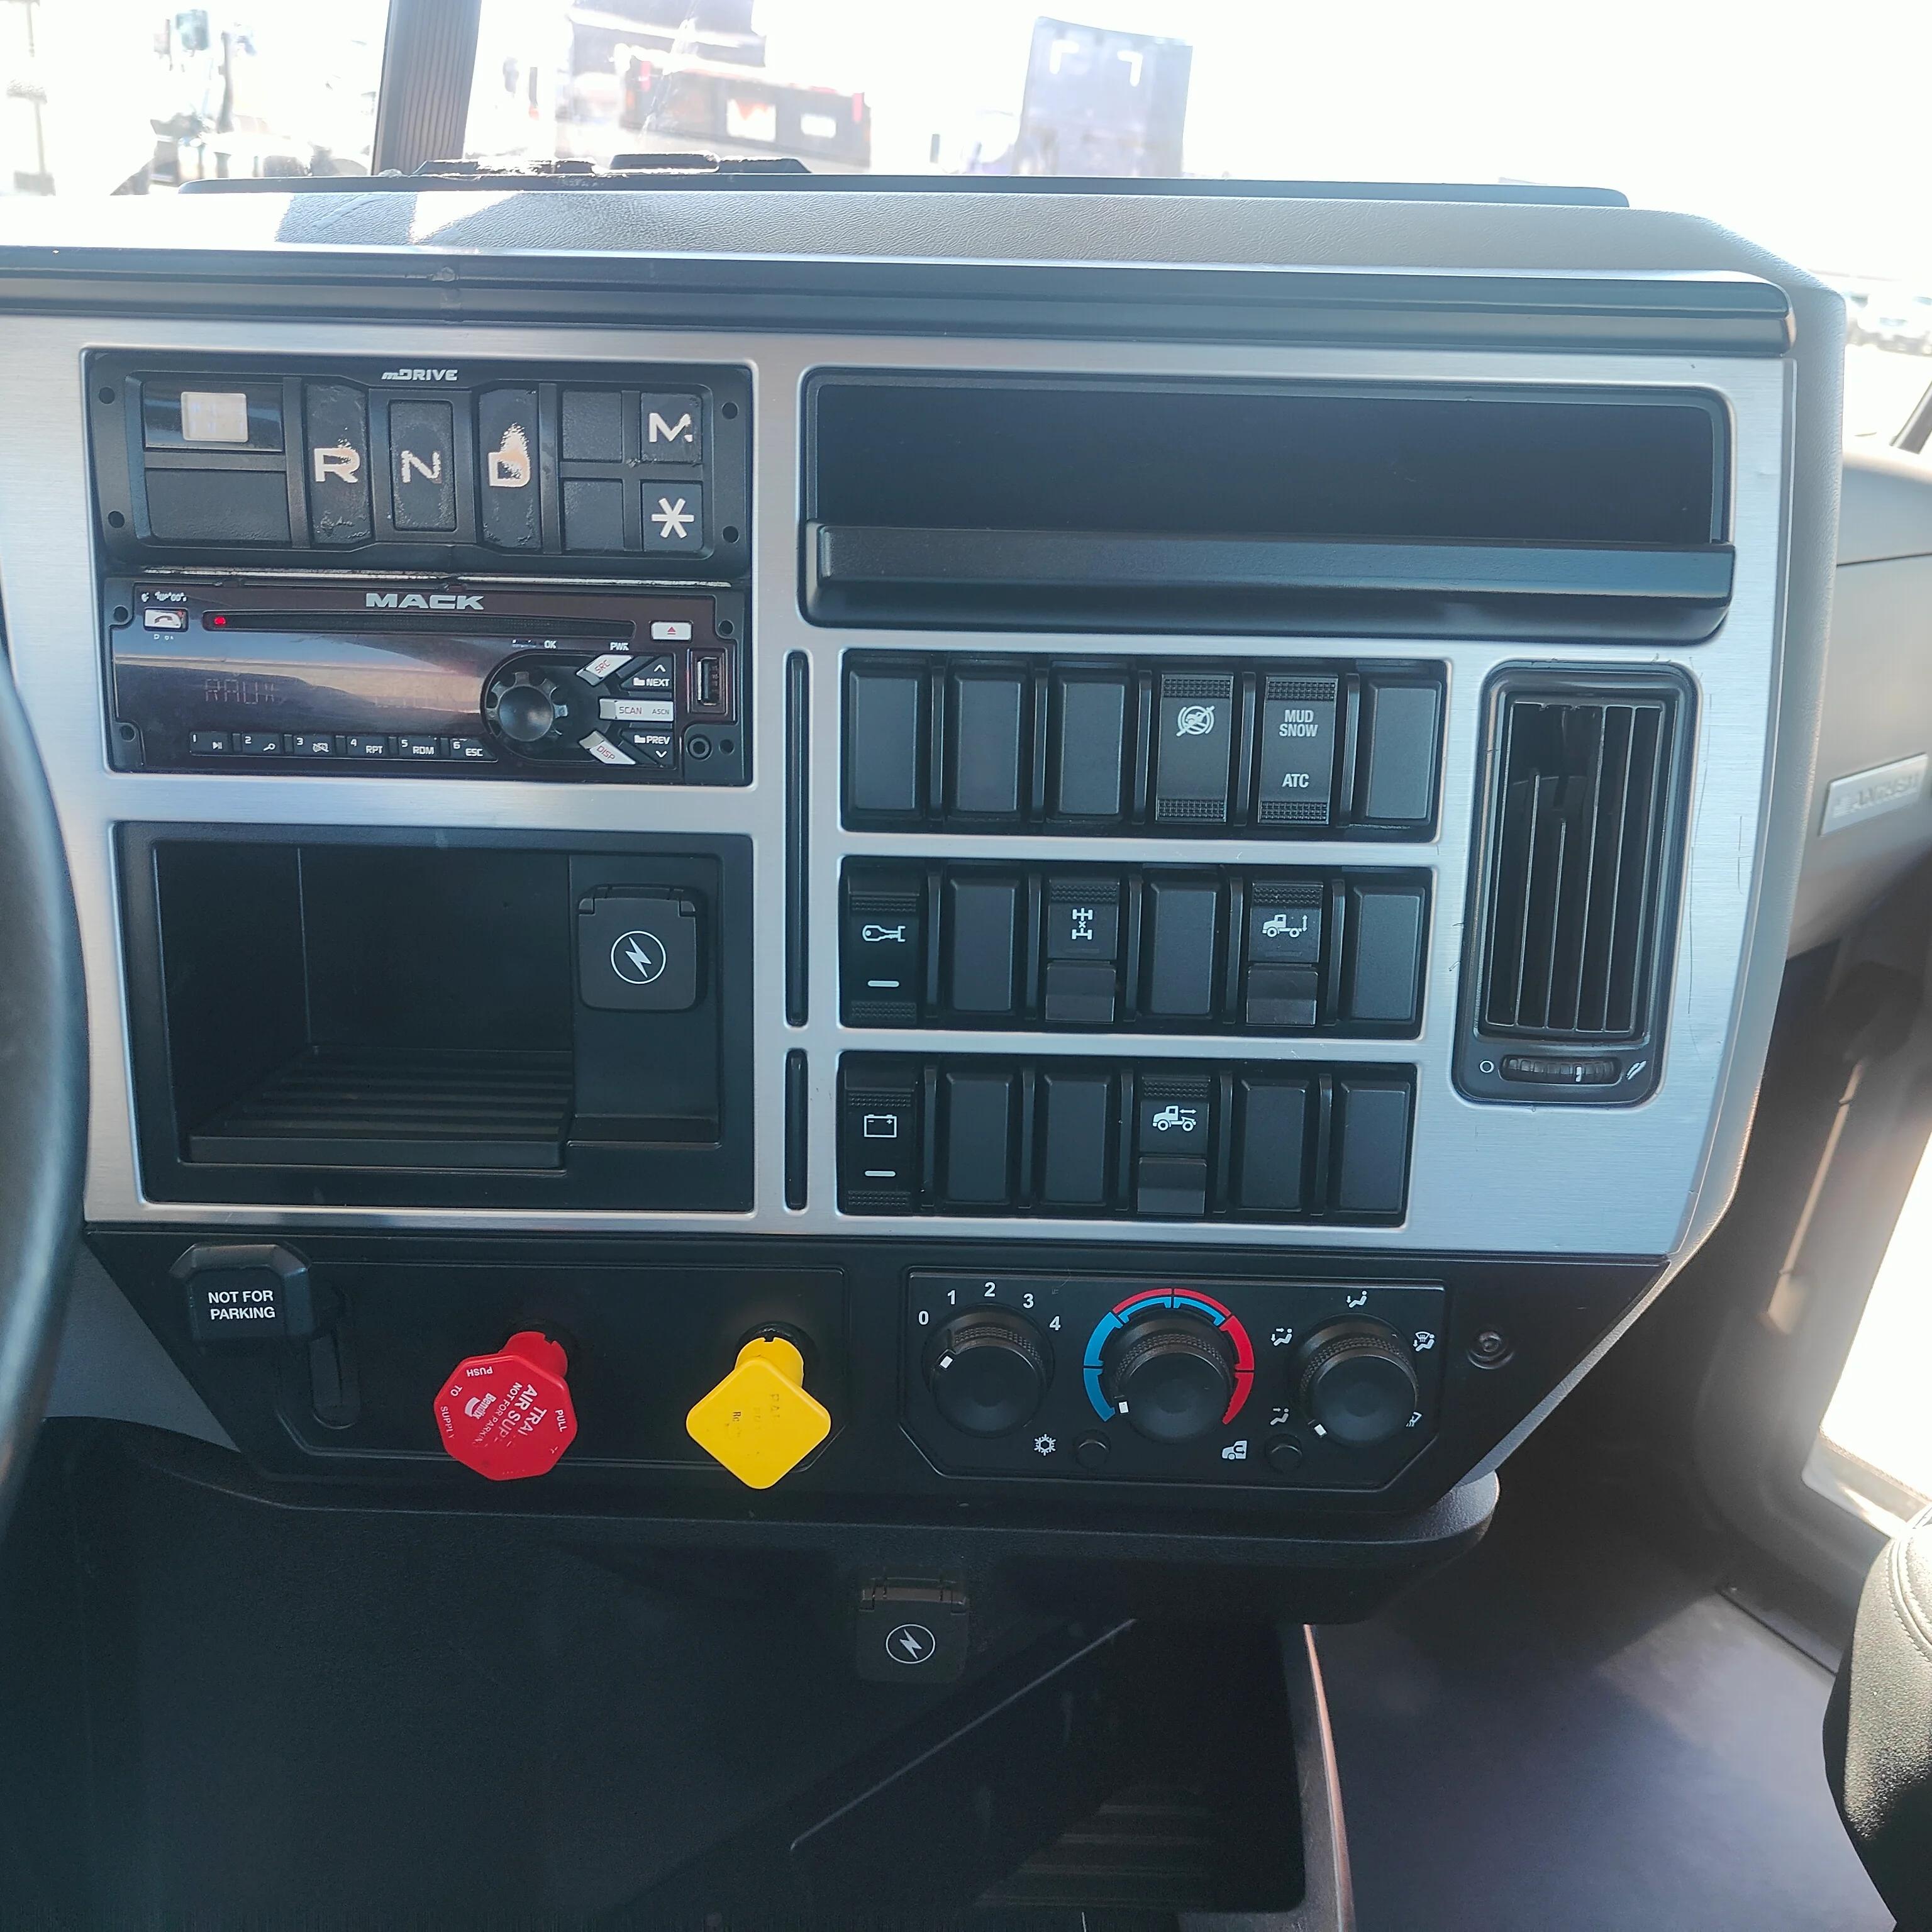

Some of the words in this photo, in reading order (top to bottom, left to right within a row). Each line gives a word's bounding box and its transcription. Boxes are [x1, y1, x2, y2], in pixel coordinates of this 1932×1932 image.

[380, 369, 458, 381] mDRIVE
[649, 413, 693, 443] M
[314, 447, 361, 483] R
[401, 449, 442, 484] N
[487, 451, 531, 487] D
[365, 592, 485, 610] MACK
[544, 640, 557, 649] OK
[594, 659, 611, 674] SRC
[646, 679, 670, 687] NEXT
[619, 706, 642, 715] SCAN
[1284, 709, 1314, 723] MUD
[1279, 723, 1319, 737] SNOW
[245, 736, 252, 744] 2
[296, 737, 304, 745] 3
[647, 735, 670, 745] PREV
[366, 745, 383, 754] RPT
[413, 746, 435, 755] RDM
[465, 748, 483, 757] ESC
[597, 745, 616, 760] DISP
[1282, 774, 1309, 788] ATC
[984, 1282, 996, 1297] 2
[208, 1291, 239, 1304] NOT
[242, 1290, 274, 1302] FOR
[947, 1290, 955, 1305] 1
[1023, 1293, 1034, 1308] 3
[210, 1306, 275, 1320] PARKING
[918, 1311, 929, 1325] 0
[1049, 1316, 1061, 1331] 4
[466, 1366, 493, 1377] PUSH
[450, 1385, 463, 1397] TO
[506, 1382, 523, 1401] NOT
[514, 1384, 538, 1411] AIR
[472, 1392, 497, 1419] Bendix
[495, 1399, 511, 1416] FOR
[555, 1409, 568, 1432] PULL
[473, 1415, 499, 1445] PARKIN
